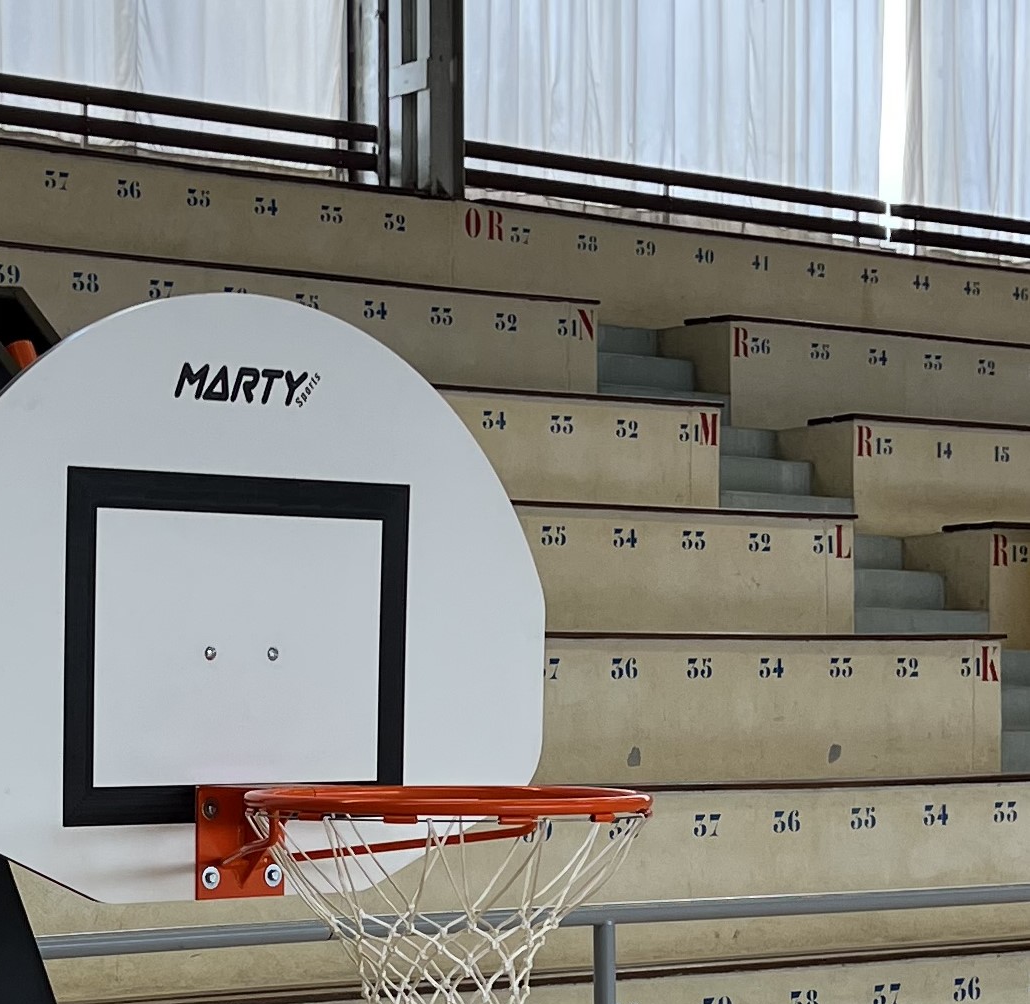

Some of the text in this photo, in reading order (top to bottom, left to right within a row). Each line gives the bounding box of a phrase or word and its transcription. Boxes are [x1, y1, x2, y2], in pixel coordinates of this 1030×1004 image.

[694, 247, 715, 264] 40
[751, 254, 769, 272] 41
[806, 261, 826, 279] 42
[912, 274, 930, 291] 44
[963, 280, 981, 296] 45
[1012, 286, 1029, 301] 46
[174, 361, 309, 407] MARTY
[936, 441, 953, 460] 14
[994, 445, 1010, 463] 15
